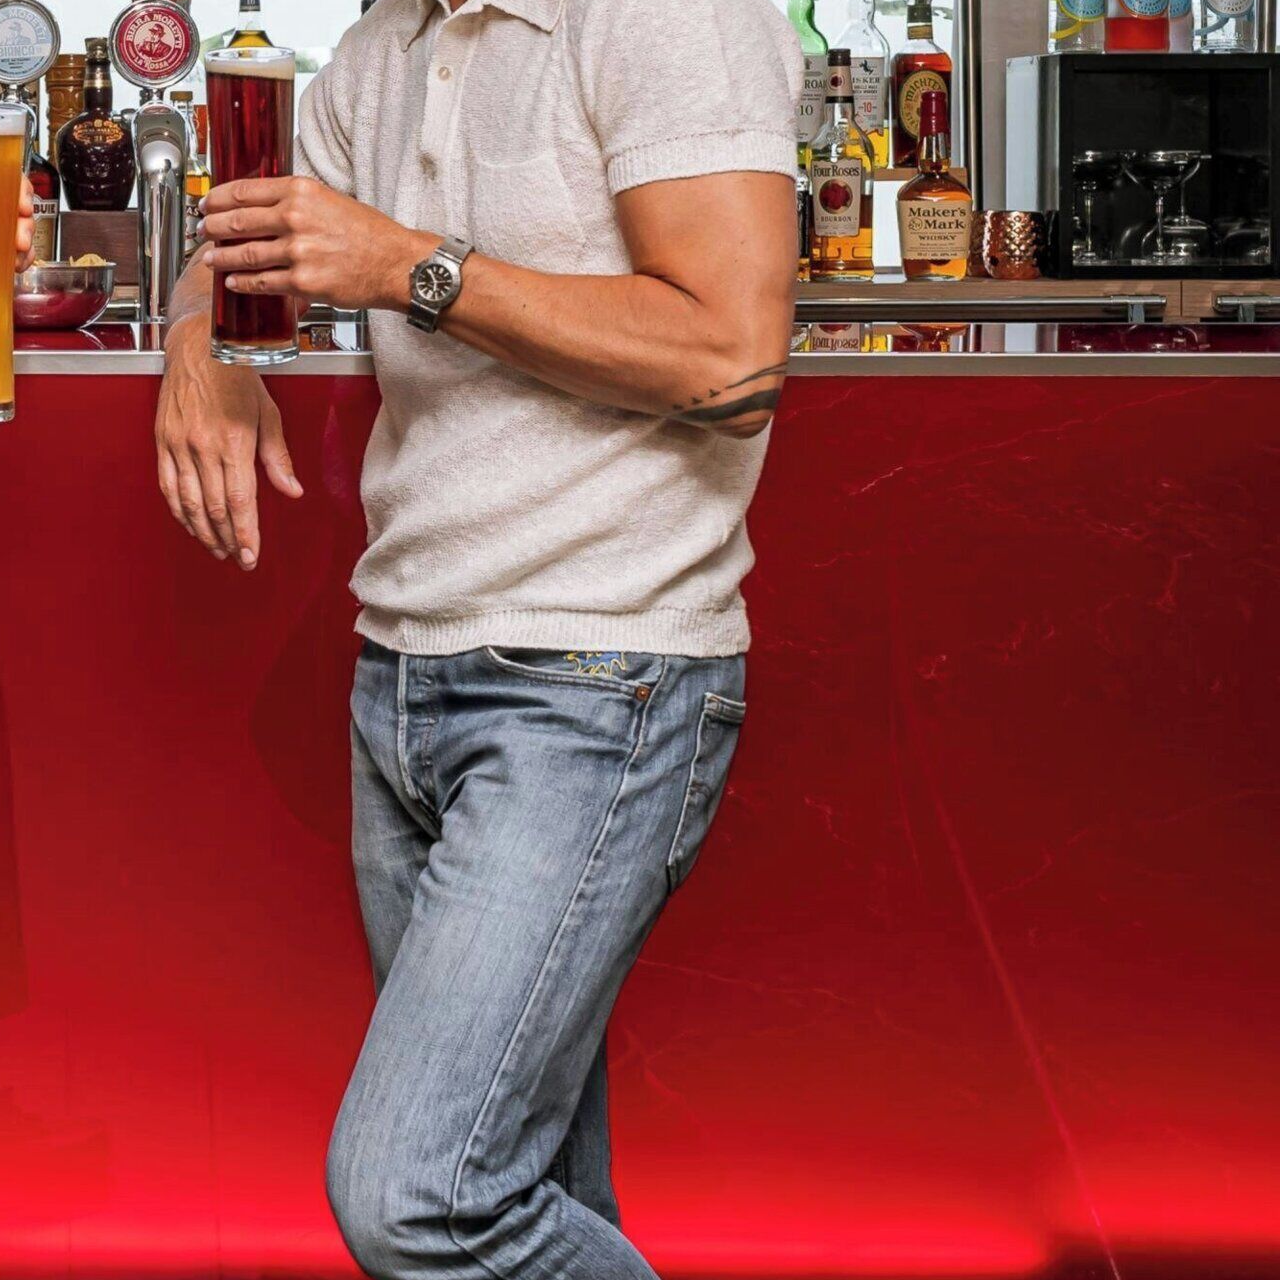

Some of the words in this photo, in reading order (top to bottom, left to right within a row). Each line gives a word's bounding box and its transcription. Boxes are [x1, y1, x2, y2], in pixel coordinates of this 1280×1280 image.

[9, 8, 46, 41] MORETTI
[126, 15, 151, 41] BIRRA
[153, 14, 182, 49] MORETTI
[145, 60, 169, 71] ROSSA
[800, 104, 813, 116] 10
[863, 102, 872, 113] 10
[814, 165, 831, 177] Four
[832, 165, 860, 177] Roses
[908, 206, 967, 217] Maker's
[924, 219, 966, 230] Mark
